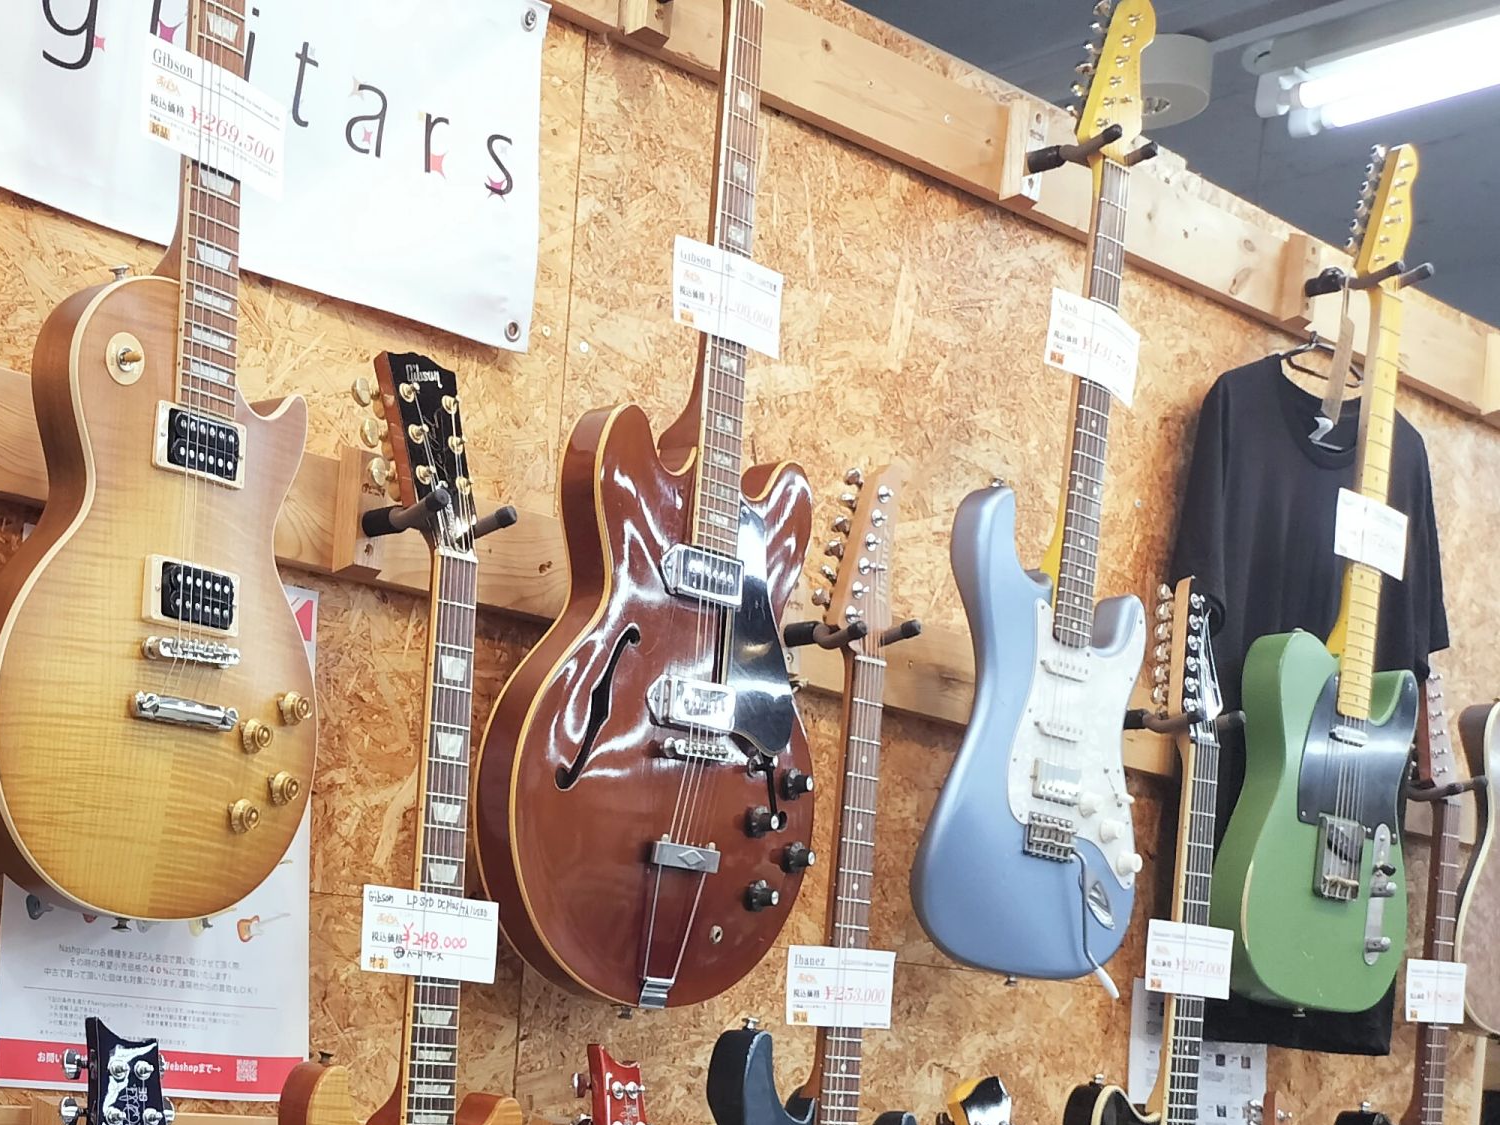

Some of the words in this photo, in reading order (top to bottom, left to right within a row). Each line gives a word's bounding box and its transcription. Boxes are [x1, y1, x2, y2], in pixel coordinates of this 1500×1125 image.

[153, 48, 193, 79] Gibson
[405, 363, 443, 389] Gibson
[794, 954, 825, 967] Ibanez
